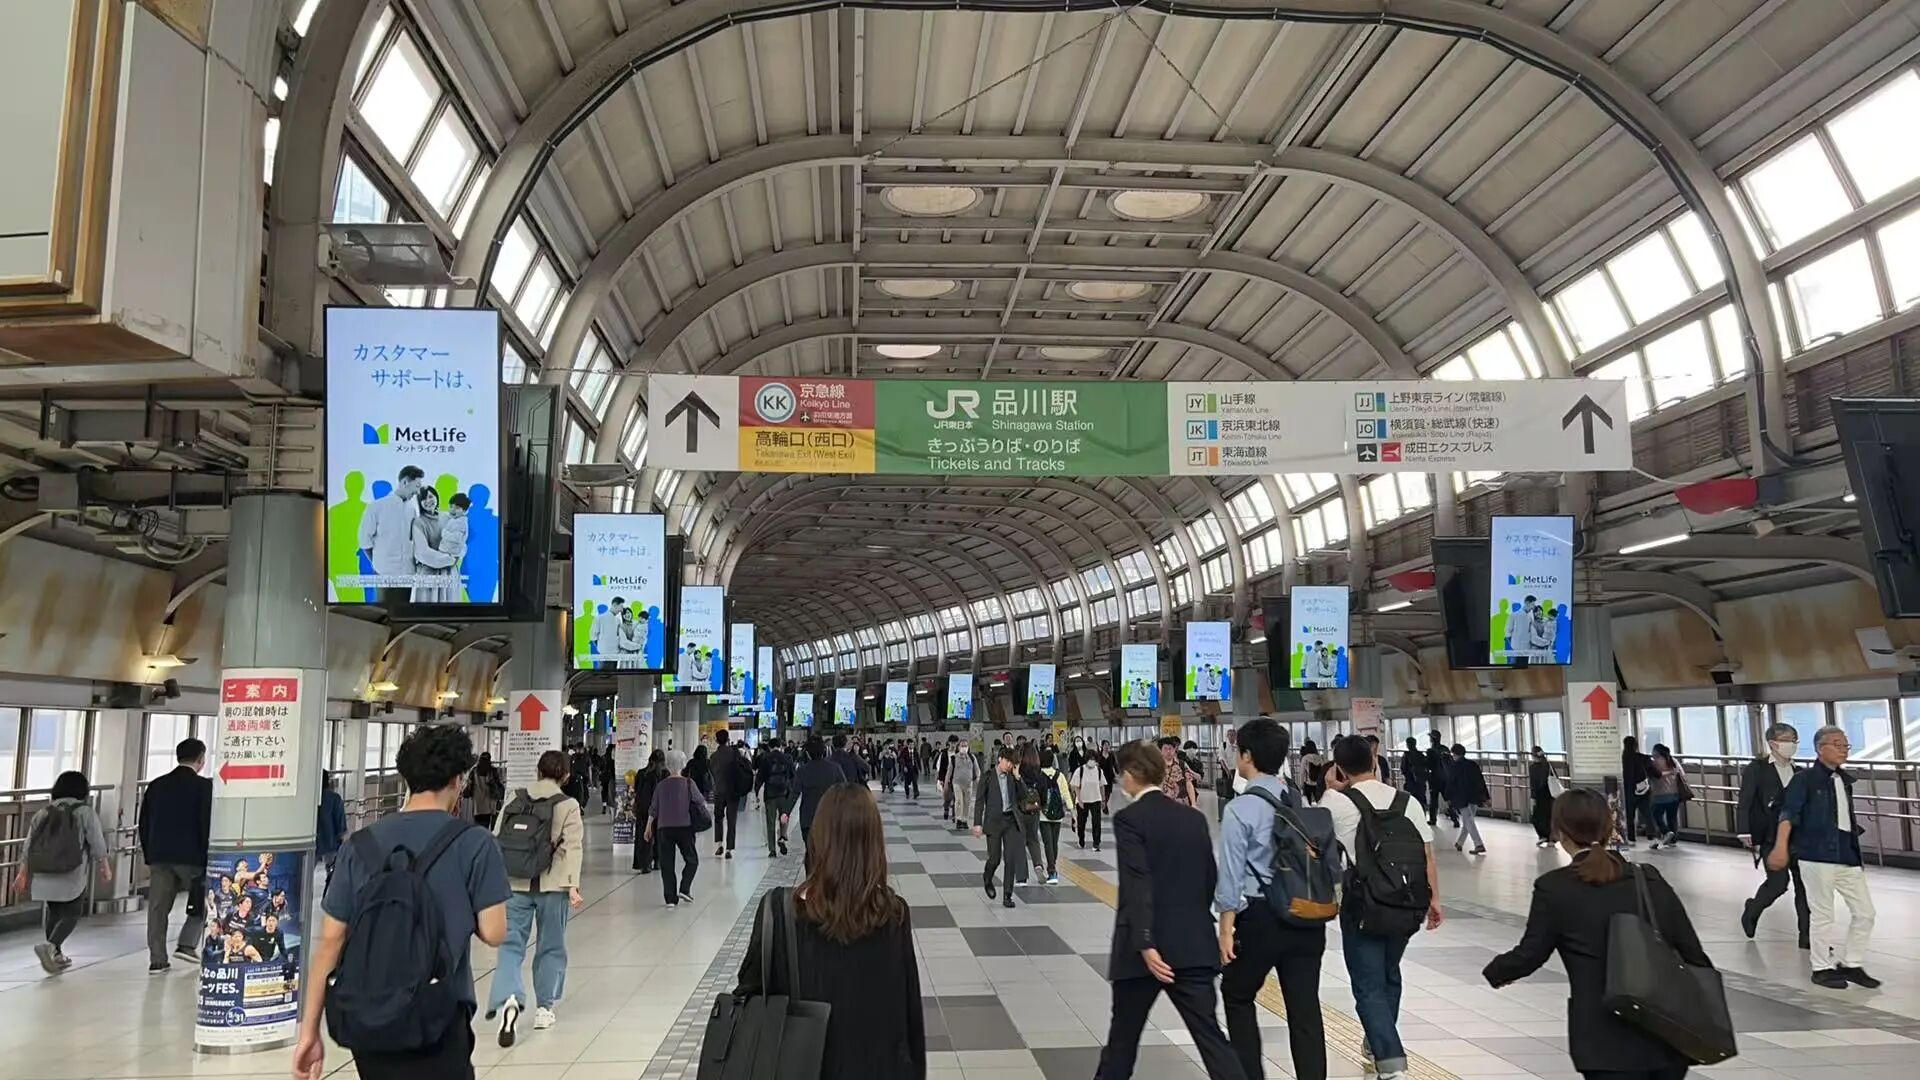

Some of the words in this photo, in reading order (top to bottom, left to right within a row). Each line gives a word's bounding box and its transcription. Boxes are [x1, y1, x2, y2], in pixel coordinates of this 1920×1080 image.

[353, 343, 450, 361] カスタマー
[370, 368, 473, 389] サポートは、
[799, 383, 845, 399] 京急線
[763, 395, 788, 410] KK
[832, 400, 851, 409] Line
[926, 389, 980, 419] JR
[992, 388, 1078, 416] 品川駅
[1189, 398, 1202, 408] JY
[1220, 393, 1256, 405] 山手線
[1359, 398, 1370, 407] JJ
[933, 420, 974, 430] JR東日本
[992, 419, 1052, 433] Shinagawa
[1055, 419, 1094, 431] Station
[1189, 425, 1203, 435] JK
[1221, 419, 1281, 432] 京浜東北線
[1359, 424, 1373, 434] JO
[395, 426, 467, 443] MetLife
[395, 444, 456, 453] メットライフ生命
[927, 437, 1082, 454] きっぷうりば・のりば
[1404, 441, 1494, 454] 成田エクスプレス
[797, 449, 812, 459] Exit
[814, 449, 836, 461] (West
[1191, 451, 1204, 461] JT
[1222, 446, 1267, 458] 東海道線
[928, 456, 980, 470] Tickets
[984, 457, 1012, 470] and
[1015, 457, 1065, 471] Tracks
[1428, 455, 1456, 463] Express
[609, 575, 648, 585] MetLife
[1523, 575, 1558, 584] MetLife
[223, 736, 286, 747] ご通行下さい
